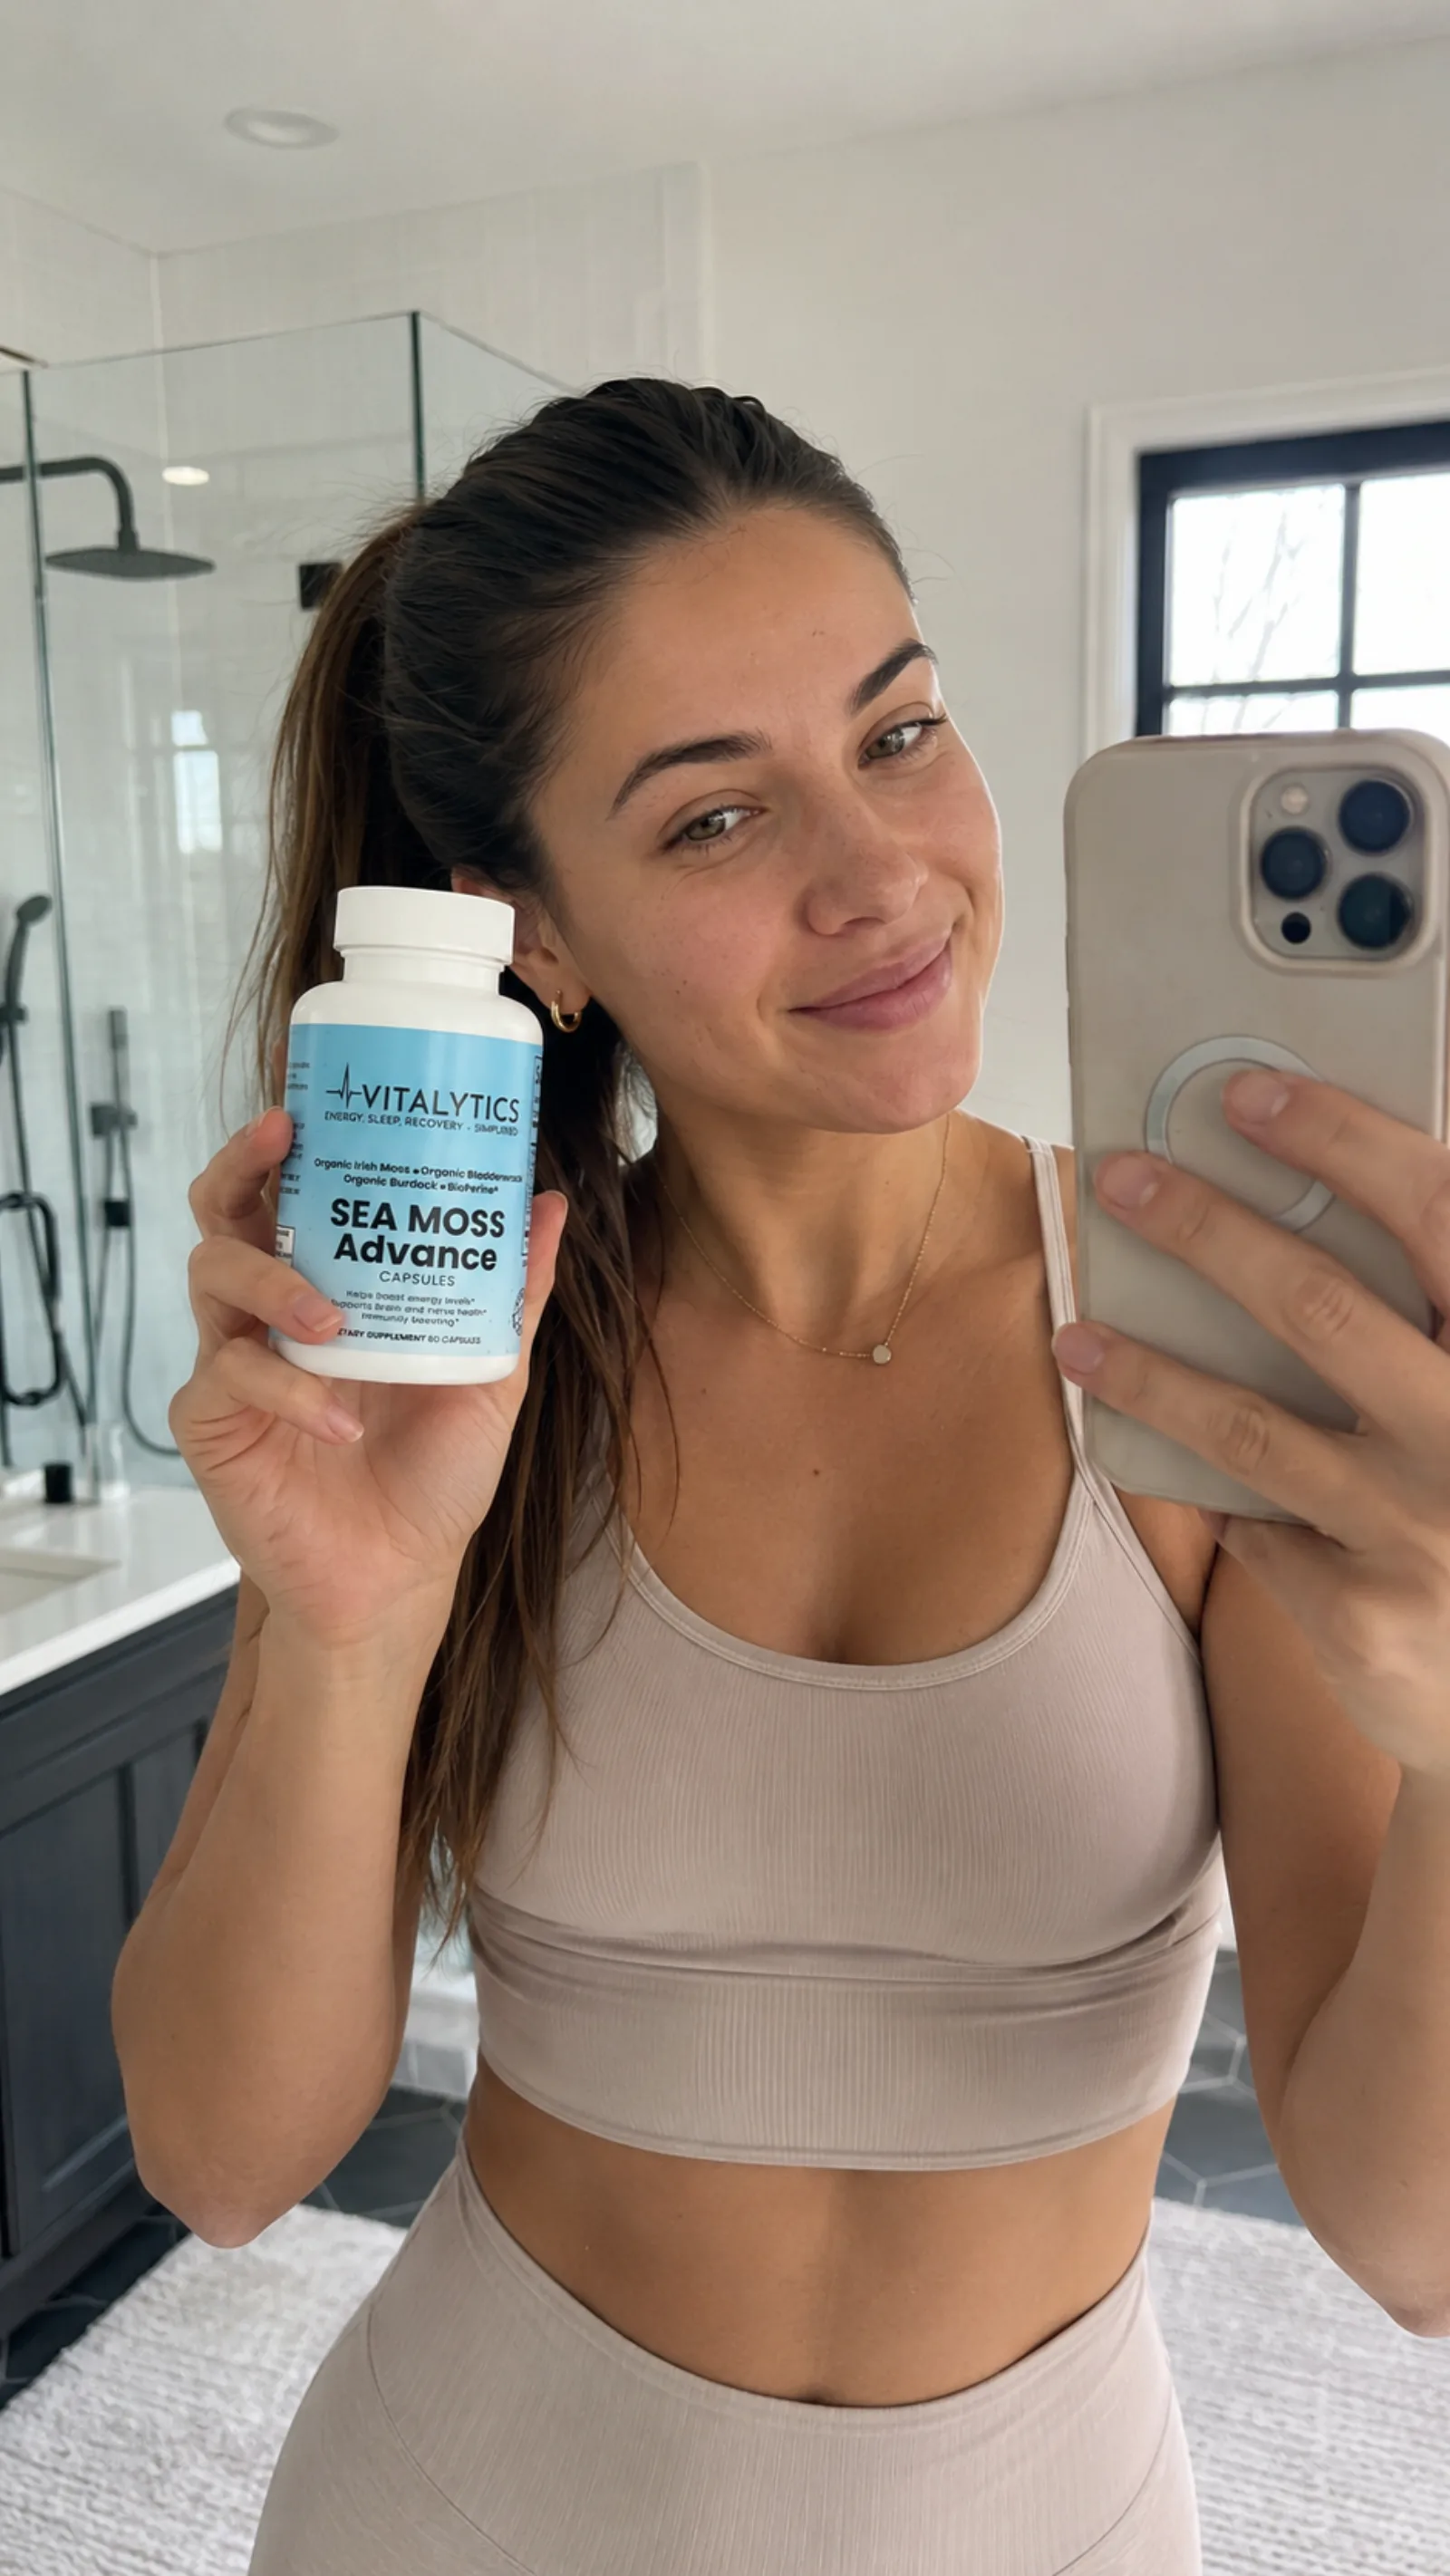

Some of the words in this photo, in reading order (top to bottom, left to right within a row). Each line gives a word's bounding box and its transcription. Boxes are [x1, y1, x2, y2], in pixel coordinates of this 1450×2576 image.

[362, 1085, 519, 1123] VITALYTICS
[405, 1117, 463, 1131] RECOVERY
[314, 1158, 352, 1171] Organic
[354, 1161, 378, 1172] Irish
[380, 1163, 410, 1173] Moss
[421, 1166, 465, 1179] Organic
[343, 1174, 387, 1187] Organic
[390, 1178, 438, 1190] Burdock
[331, 1199, 397, 1230] SEA
[409, 1205, 505, 1238] MOSS
[334, 1233, 497, 1270] Advance
[380, 1270, 455, 1287] CAPSULES
[404, 1306, 424, 1314] and
